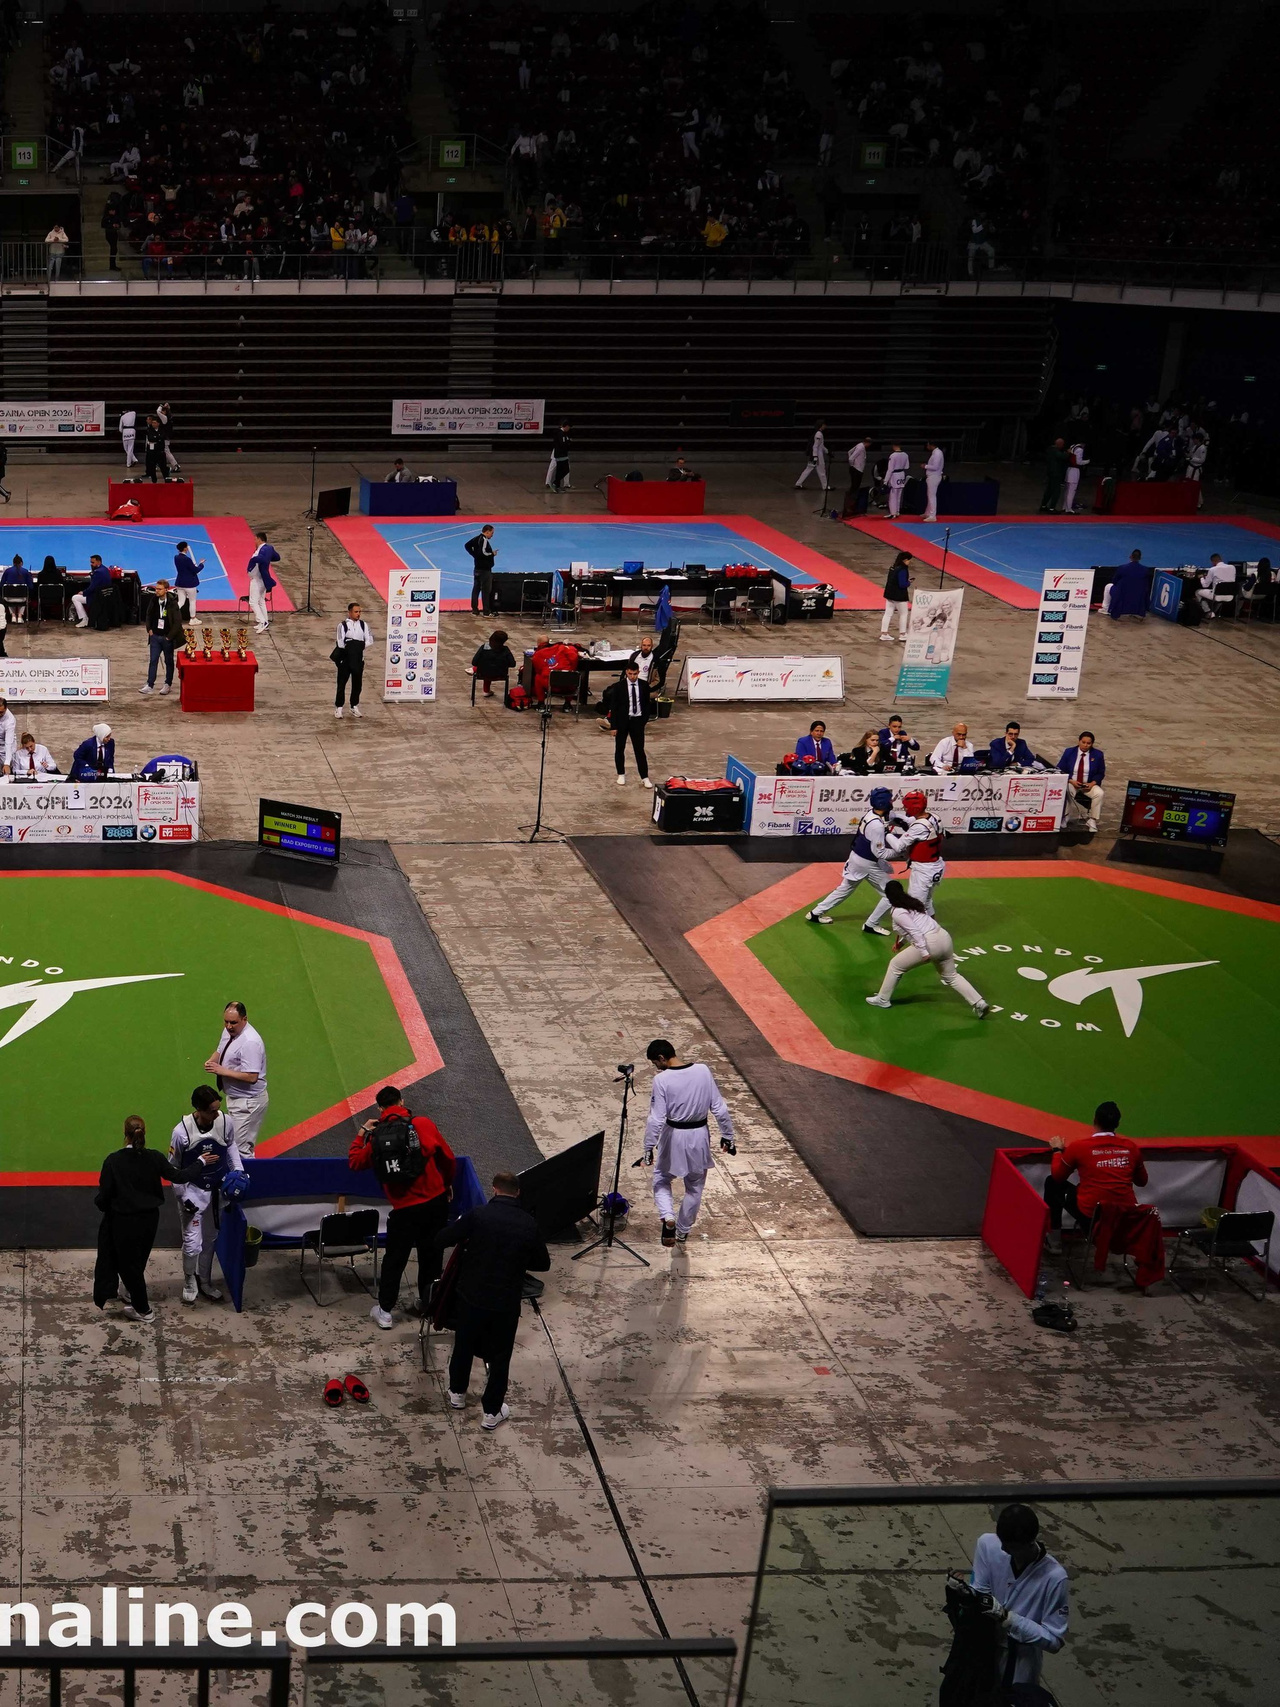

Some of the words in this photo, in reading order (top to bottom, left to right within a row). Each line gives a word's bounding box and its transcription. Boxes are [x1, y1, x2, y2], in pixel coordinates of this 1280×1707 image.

[18, 152, 31, 160] 113
[445, 150, 459, 158] 112
[27, 409, 51, 417] OPEN
[52, 409, 73, 417] 2026
[424, 407, 465, 415] BULGARIA
[468, 407, 491, 415] OPEN
[492, 407, 513, 415] 2026
[1160, 582, 1170, 608] 6
[950, 782, 957, 791] 2
[73, 790, 80, 799] 3
[962, 789, 1002, 801] 2026
[36, 796, 68, 809] OPE
[89, 796, 132, 809] 2026
[1143, 805, 1156, 820] 2
[1165, 813, 1186, 822] 3.03
[1195, 812, 1208, 827] 2
[274, 821, 297, 830] WINNER
[814, 826, 841, 834] Daedo
[295, 841, 318, 850] EXPOSITO
[990, 1004, 1102, 1032] WORL
